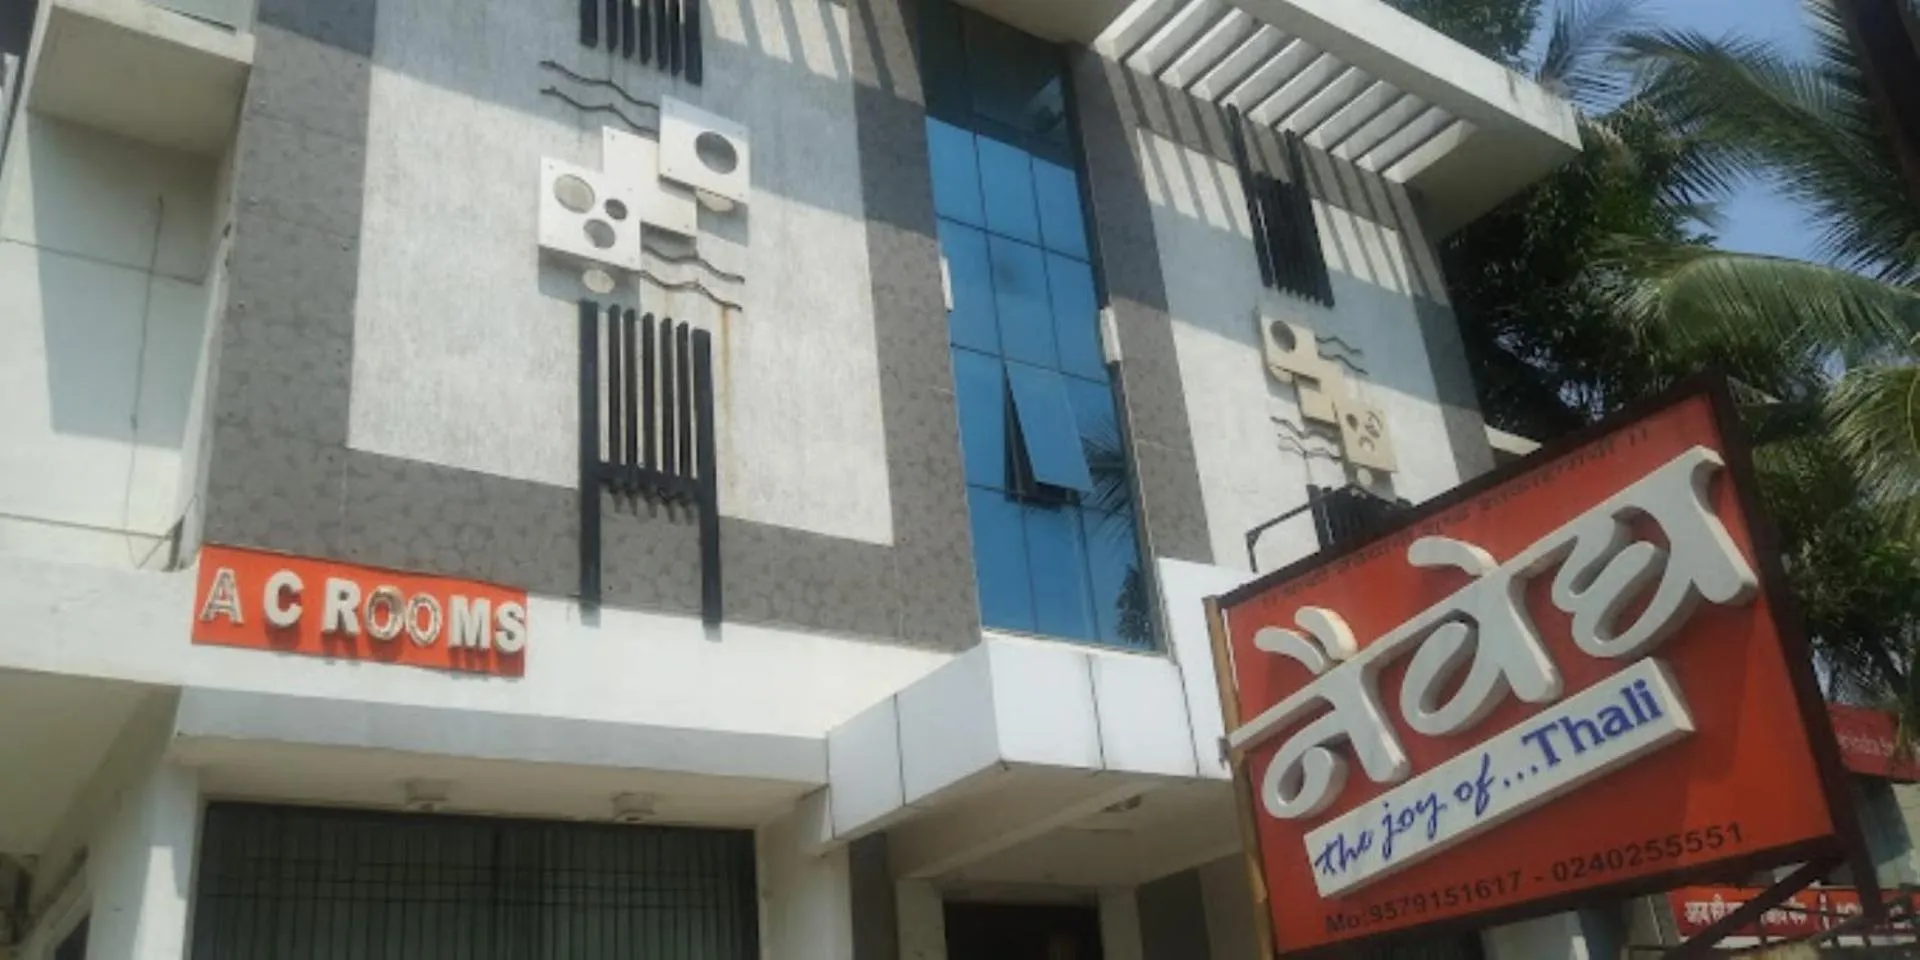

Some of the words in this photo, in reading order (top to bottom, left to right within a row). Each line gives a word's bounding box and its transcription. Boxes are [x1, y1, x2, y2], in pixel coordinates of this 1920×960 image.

[200, 567, 243, 624] A
[263, 570, 304, 627] C
[319, 577, 527, 653] ROOMS
[1314, 831, 1374, 877] the
[1381, 792, 1448, 859] joy
[1552, 821, 1743, 882] 0240255551
